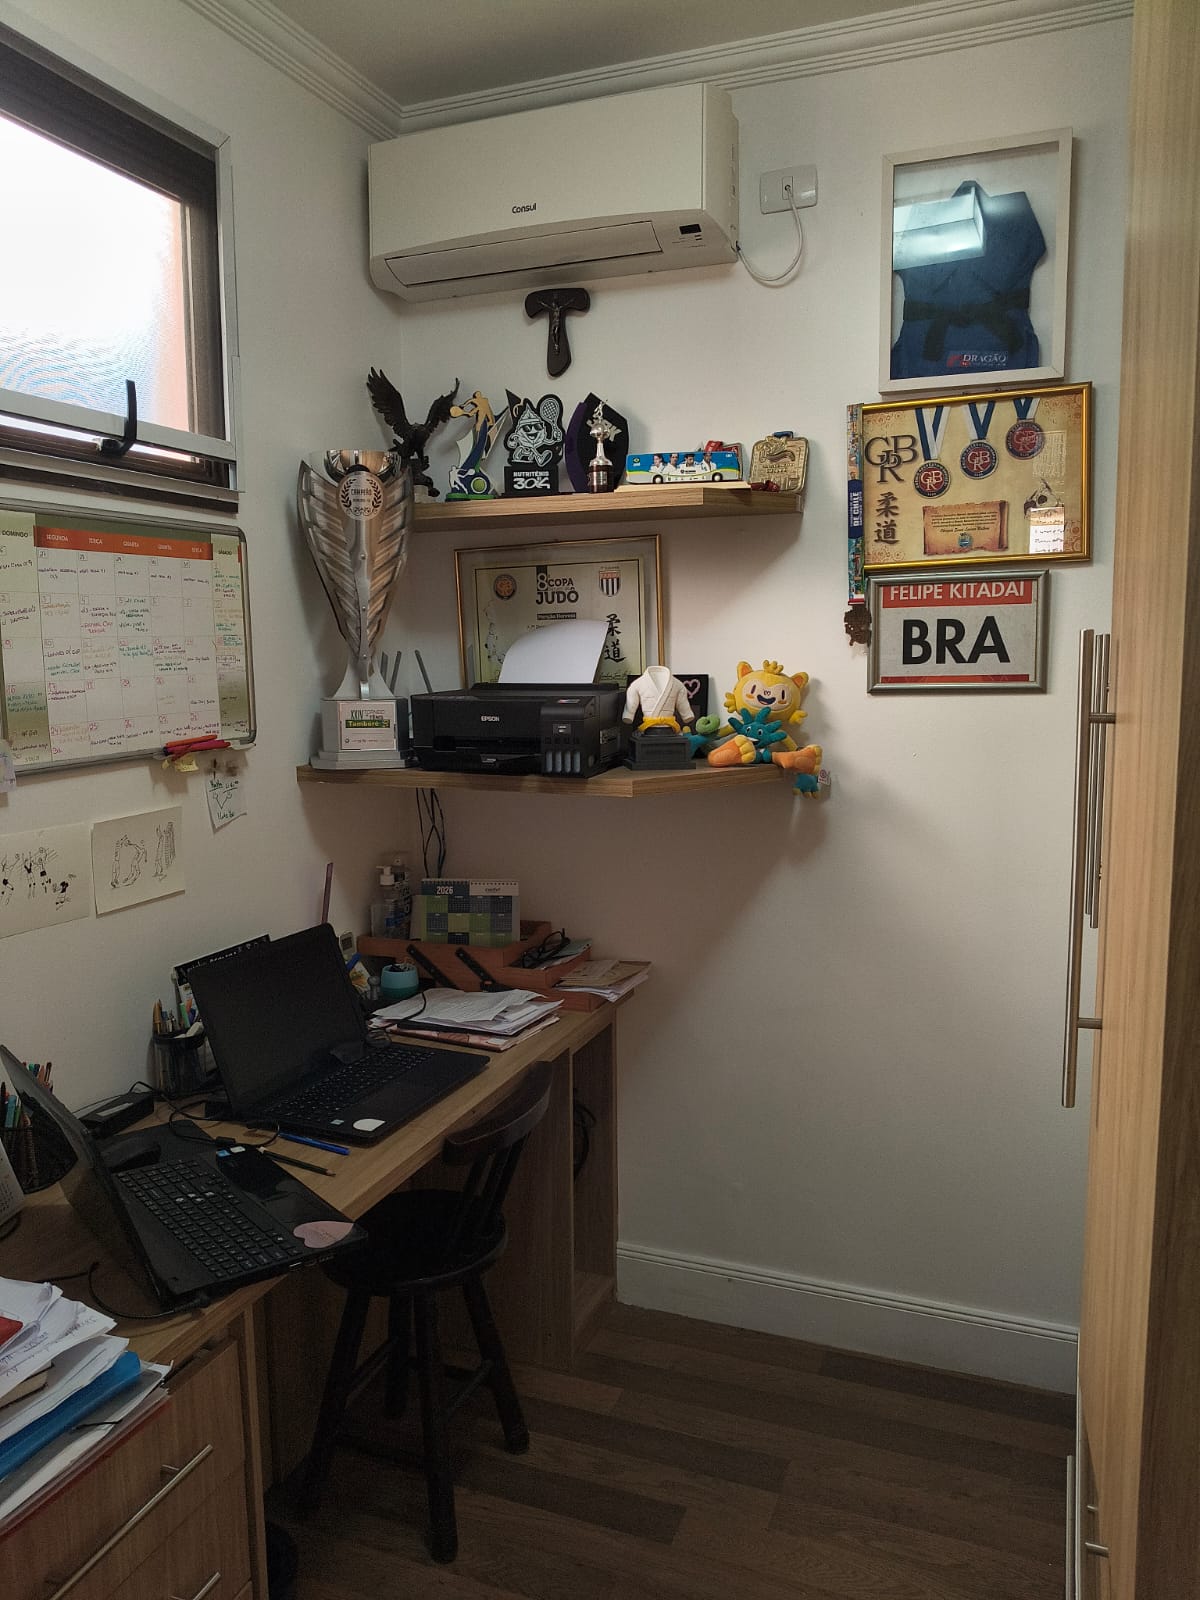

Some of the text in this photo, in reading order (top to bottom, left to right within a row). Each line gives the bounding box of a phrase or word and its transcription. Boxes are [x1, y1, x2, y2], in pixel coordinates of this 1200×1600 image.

[511, 203, 537, 213] Consul
[963, 353, 1007, 363] DRAGÃO
[1, 530, 29, 540] DOMINGO
[548, 578, 574, 587] COPA
[890, 581, 1024, 600] FELIPE KITADAI
[536, 587, 579, 605] JUDÔ
[902, 615, 1011, 665] BRA
[436, 886, 454, 895] 2026
